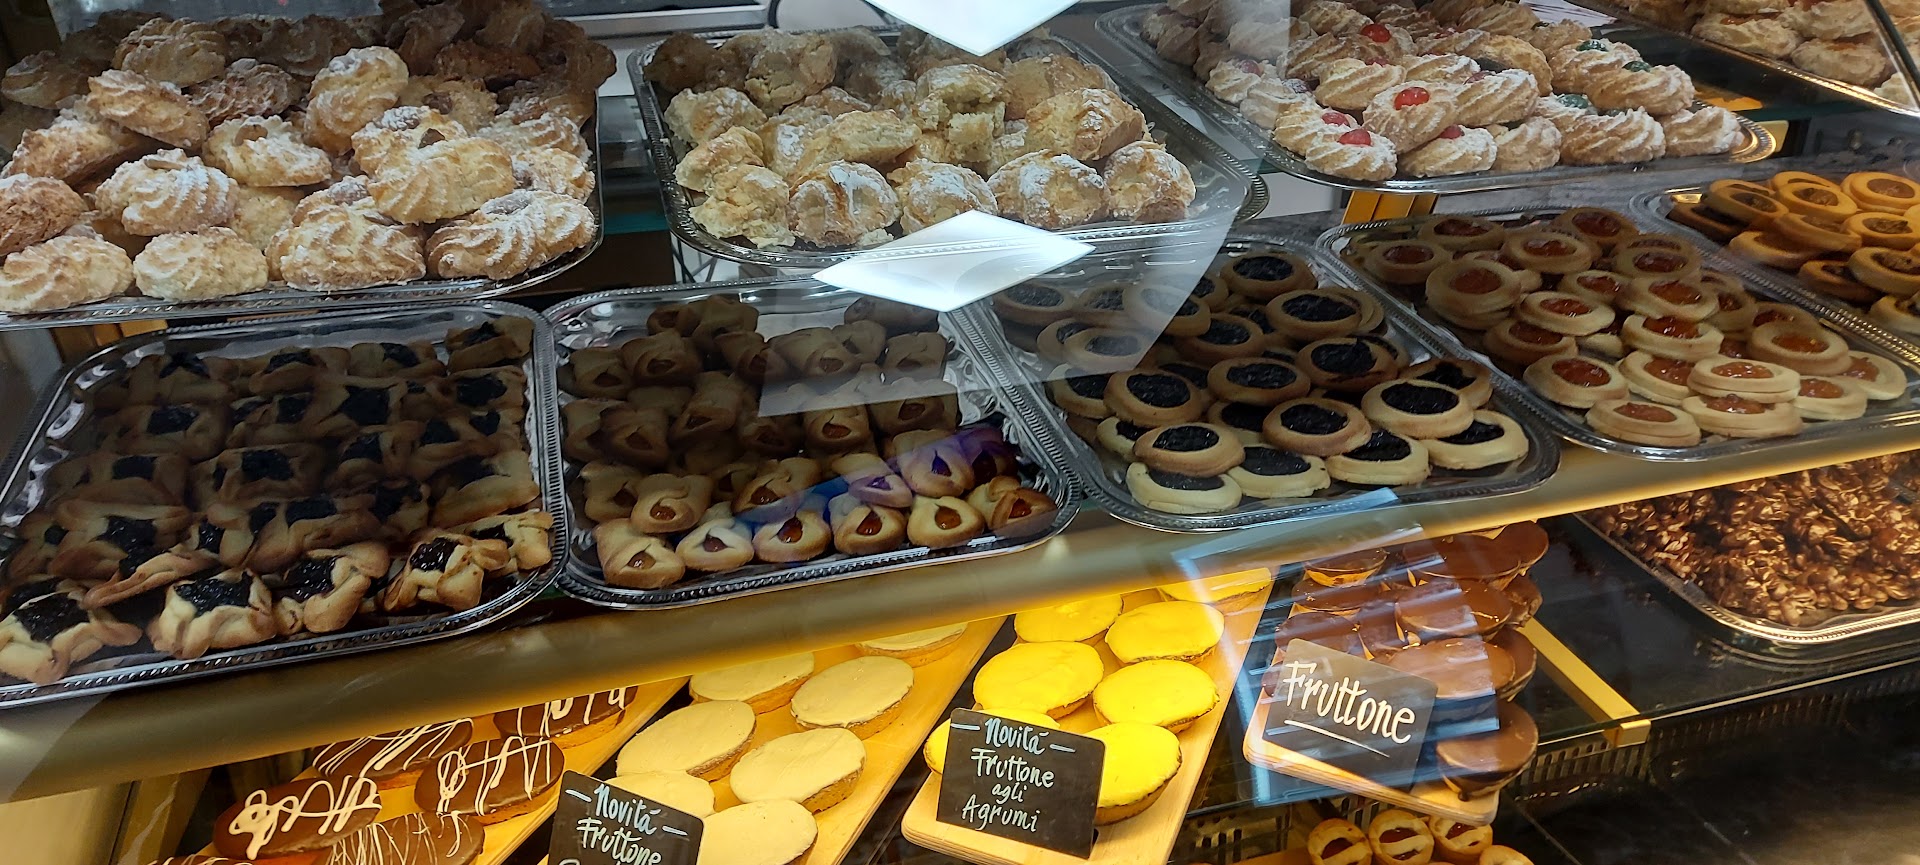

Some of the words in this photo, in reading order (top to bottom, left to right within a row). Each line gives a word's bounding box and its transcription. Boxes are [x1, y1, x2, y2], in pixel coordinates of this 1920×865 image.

[1282, 660, 1416, 744] Fruttone
[970, 747, 1055, 788] Fruttone
[961, 794, 1041, 832] Agrumi
[991, 782, 1028, 804] agli
[576, 817, 662, 865] Fruttone
